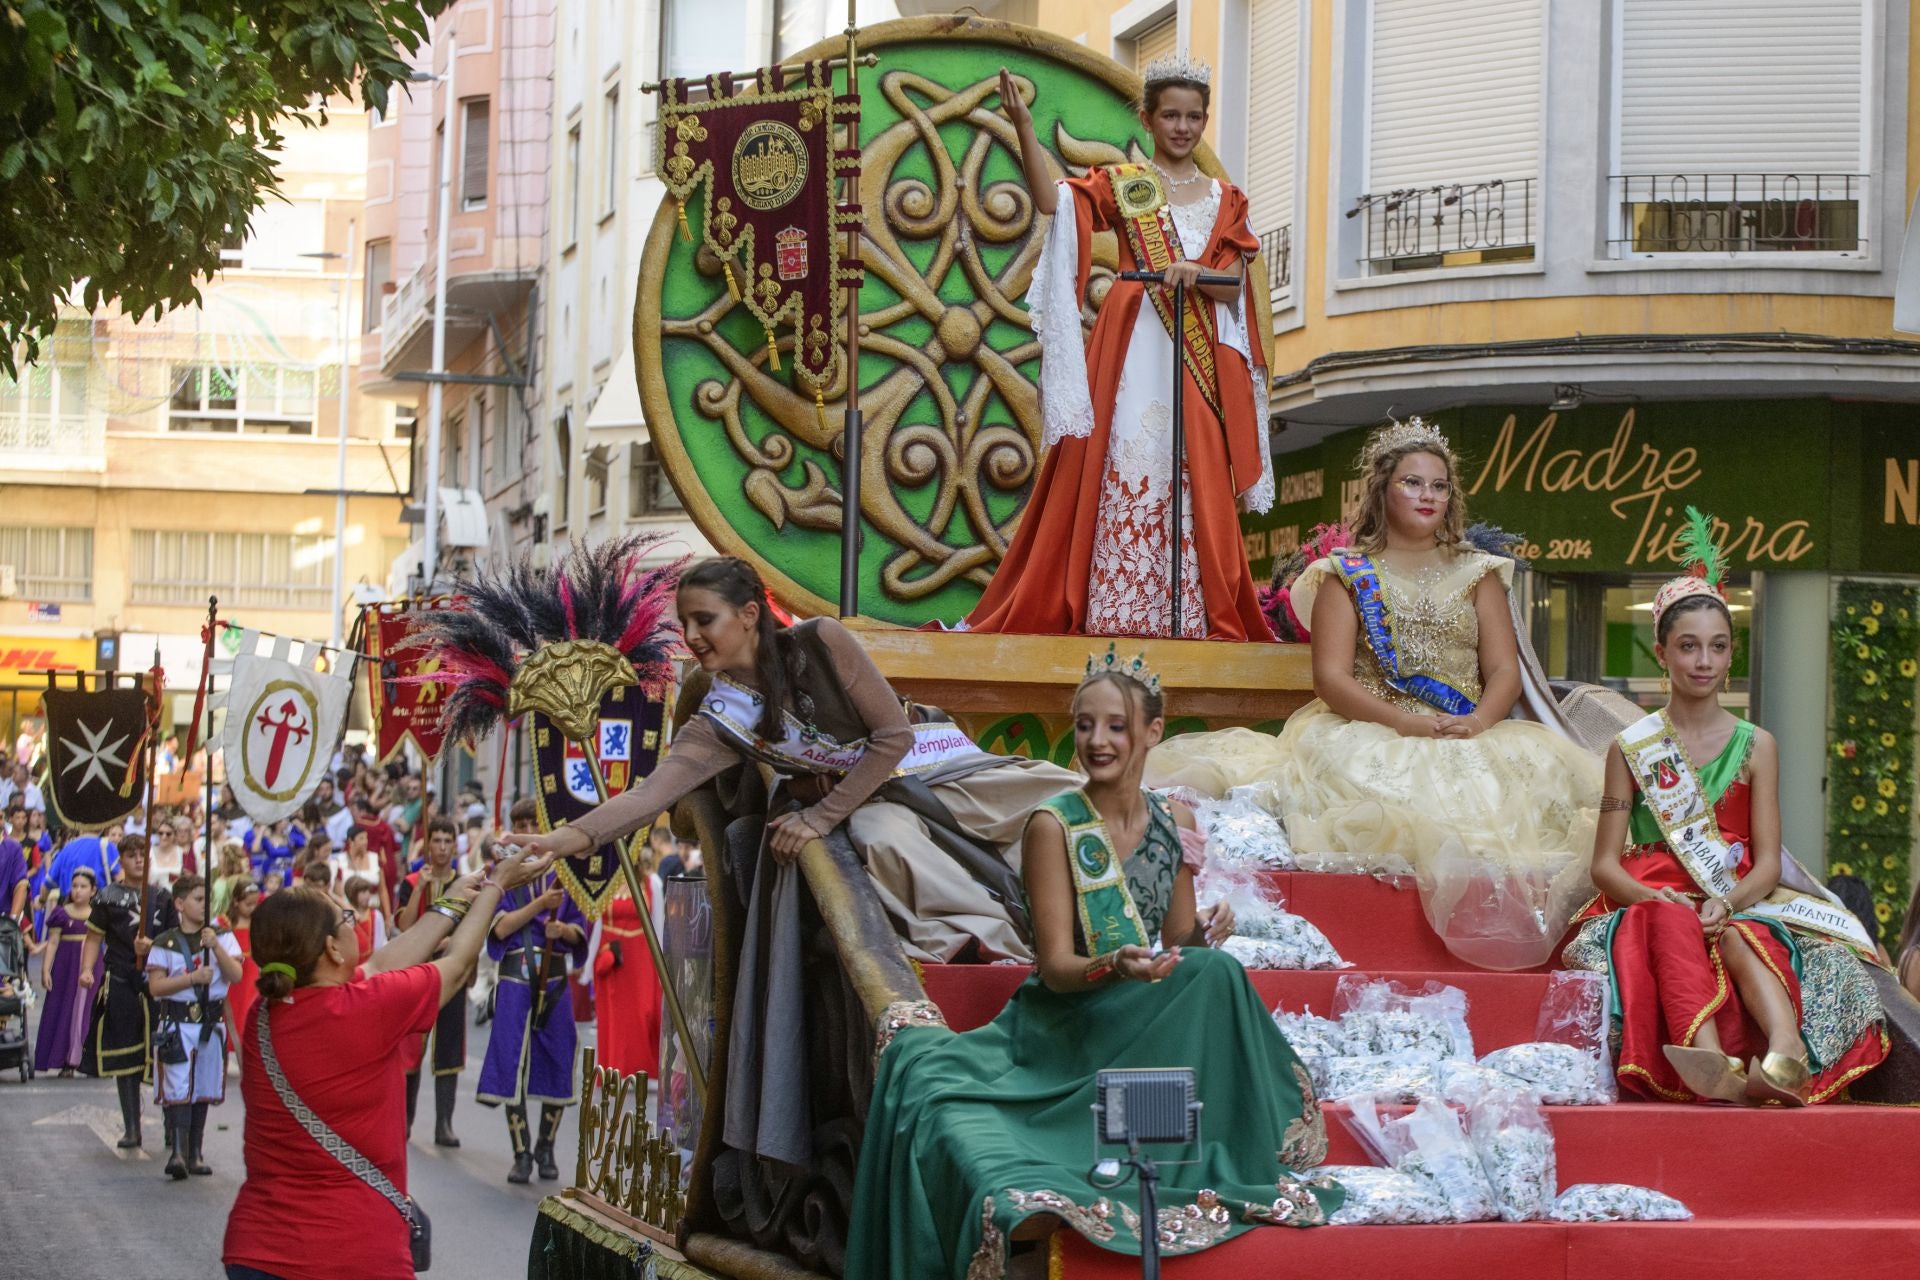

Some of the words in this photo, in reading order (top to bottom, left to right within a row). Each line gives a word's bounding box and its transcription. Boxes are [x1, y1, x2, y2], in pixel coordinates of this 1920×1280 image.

[1468, 408, 1702, 495] Madre
[1545, 539, 1593, 559] 2014
[1689, 840, 1731, 896] ABANDER
[1781, 903, 1849, 930] INFANTIL
